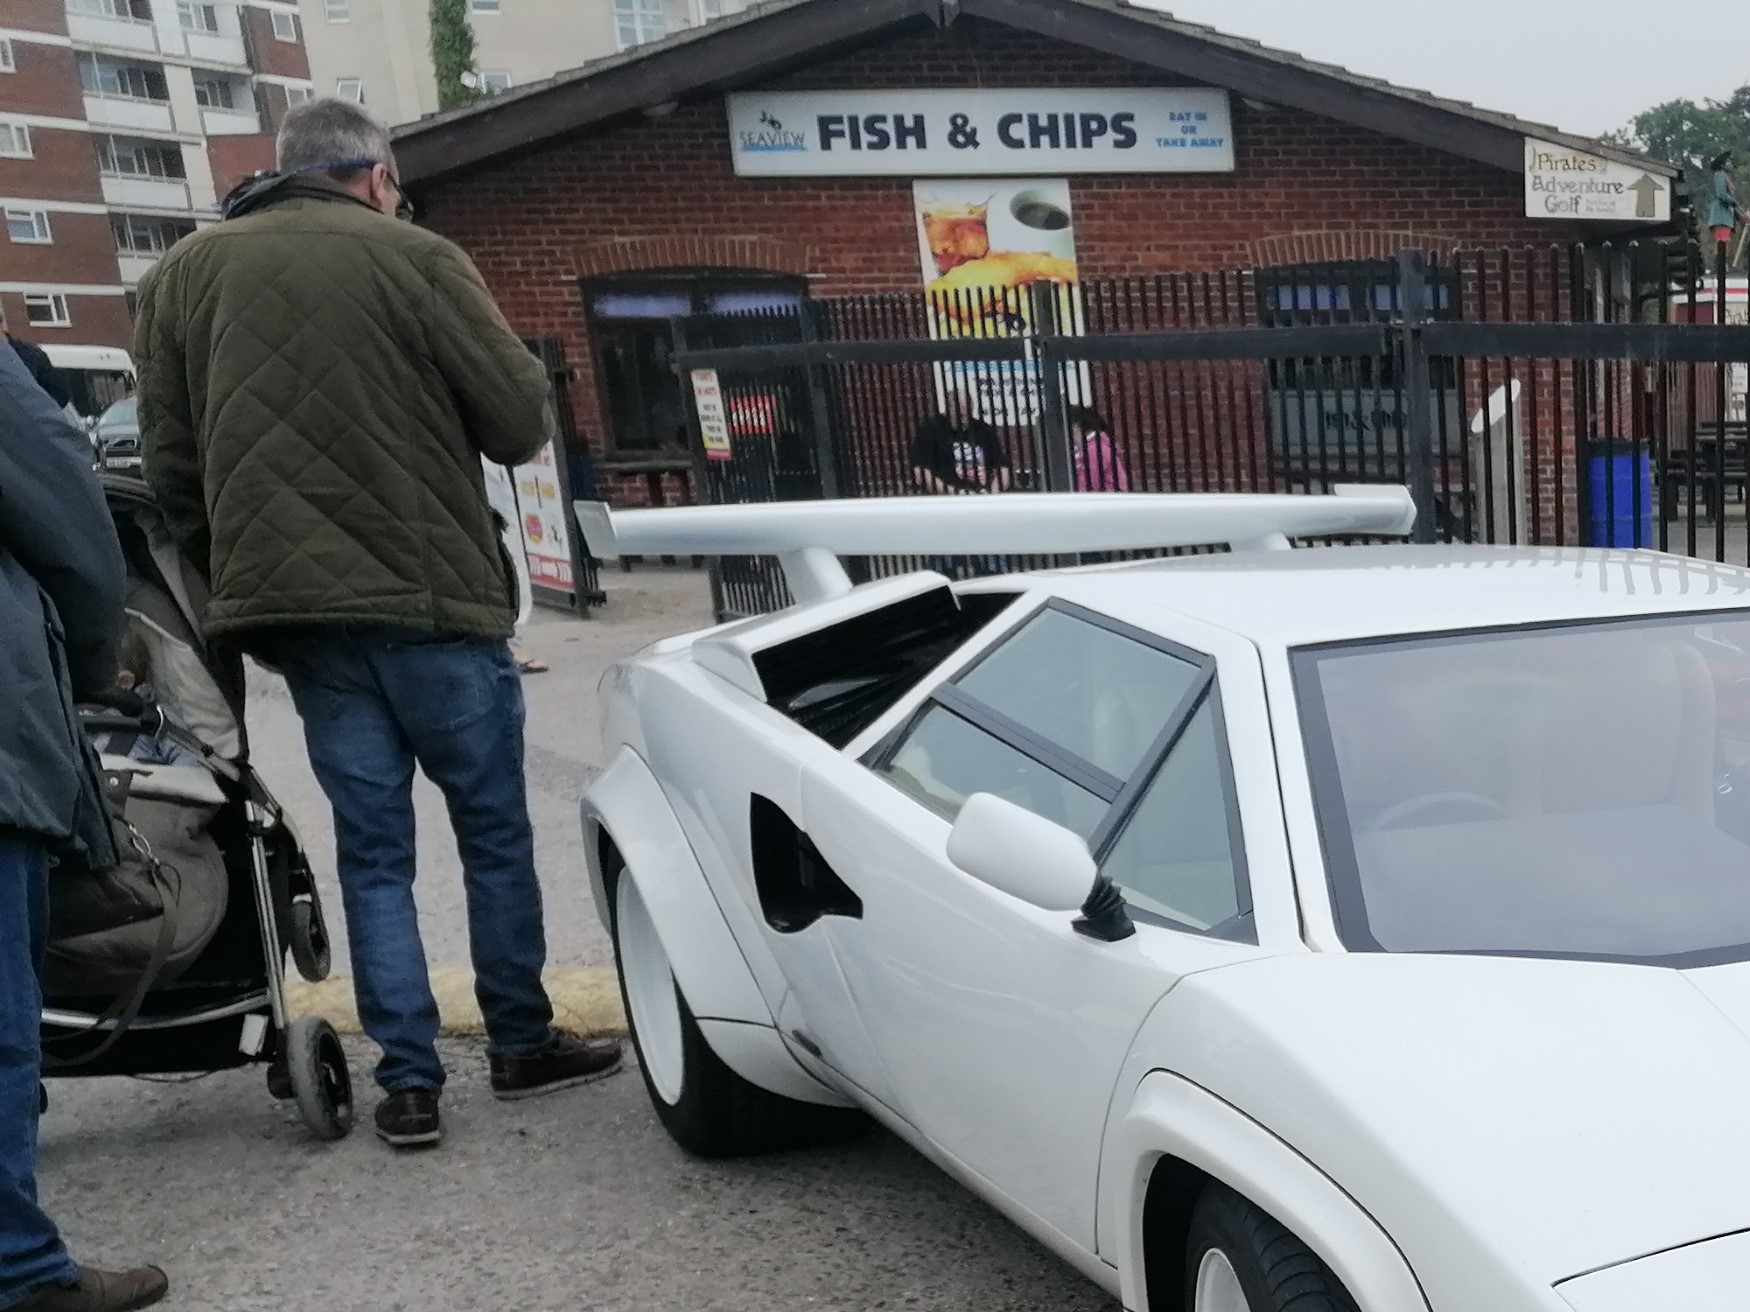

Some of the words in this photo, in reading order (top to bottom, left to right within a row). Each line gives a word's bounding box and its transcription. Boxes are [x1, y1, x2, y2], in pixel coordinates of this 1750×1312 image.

[1168, 112, 1191, 121] EAT
[816, 113, 927, 151] FISH
[947, 112, 981, 149] &
[996, 111, 1138, 149] CHIPS
[1181, 125, 1197, 134] OR
[740, 131, 805, 146] SEAVIEW
[1156, 138, 1187, 147] TAKE
[1190, 138, 1223, 147] AWAY
[1538, 153, 1596, 171] Pirates
[1532, 175, 1624, 194] Adventure
[1545, 195, 1582, 214] Golf
